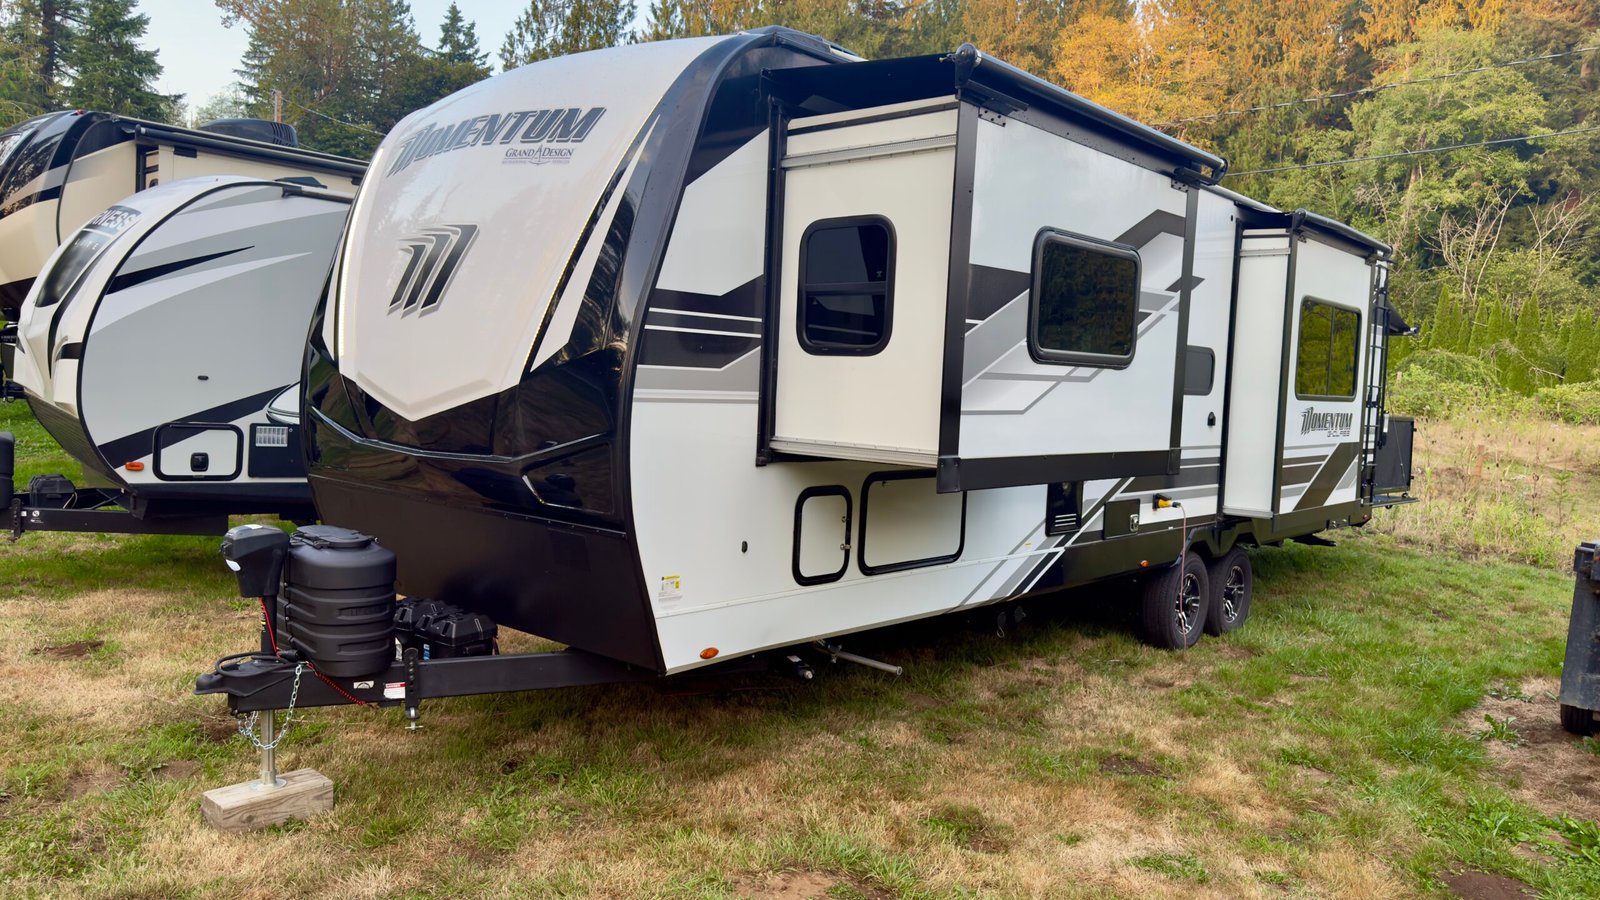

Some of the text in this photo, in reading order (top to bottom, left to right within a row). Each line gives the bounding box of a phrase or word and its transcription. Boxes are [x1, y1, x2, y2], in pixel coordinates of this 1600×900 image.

[386, 107, 607, 178] MOMENTUM
[505, 147, 575, 157] GRAND DESIGN
[1300, 406, 1353, 435] MOMENTUM
